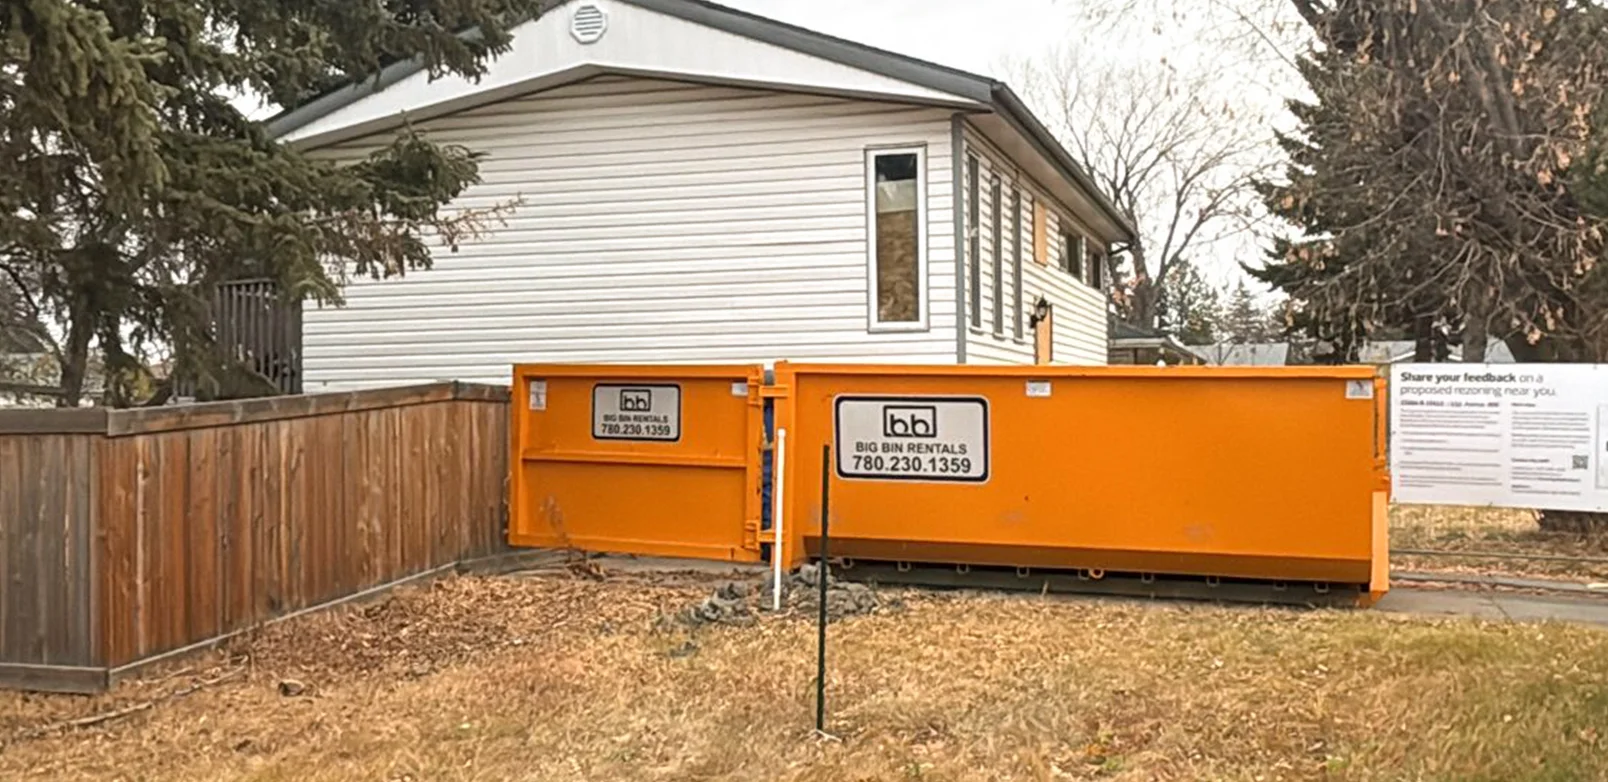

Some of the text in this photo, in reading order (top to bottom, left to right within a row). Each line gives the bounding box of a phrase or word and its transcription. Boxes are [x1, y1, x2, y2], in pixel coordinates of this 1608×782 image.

[1400, 372, 1544, 384] Share your feedback on a
[1400, 386, 1556, 398] proposed rezoning near you.
[602, 423, 670, 436] 780.230.1359
[856, 442, 967, 455] BIG BIN RENTALS
[852, 455, 972, 473] 780.230.1359
